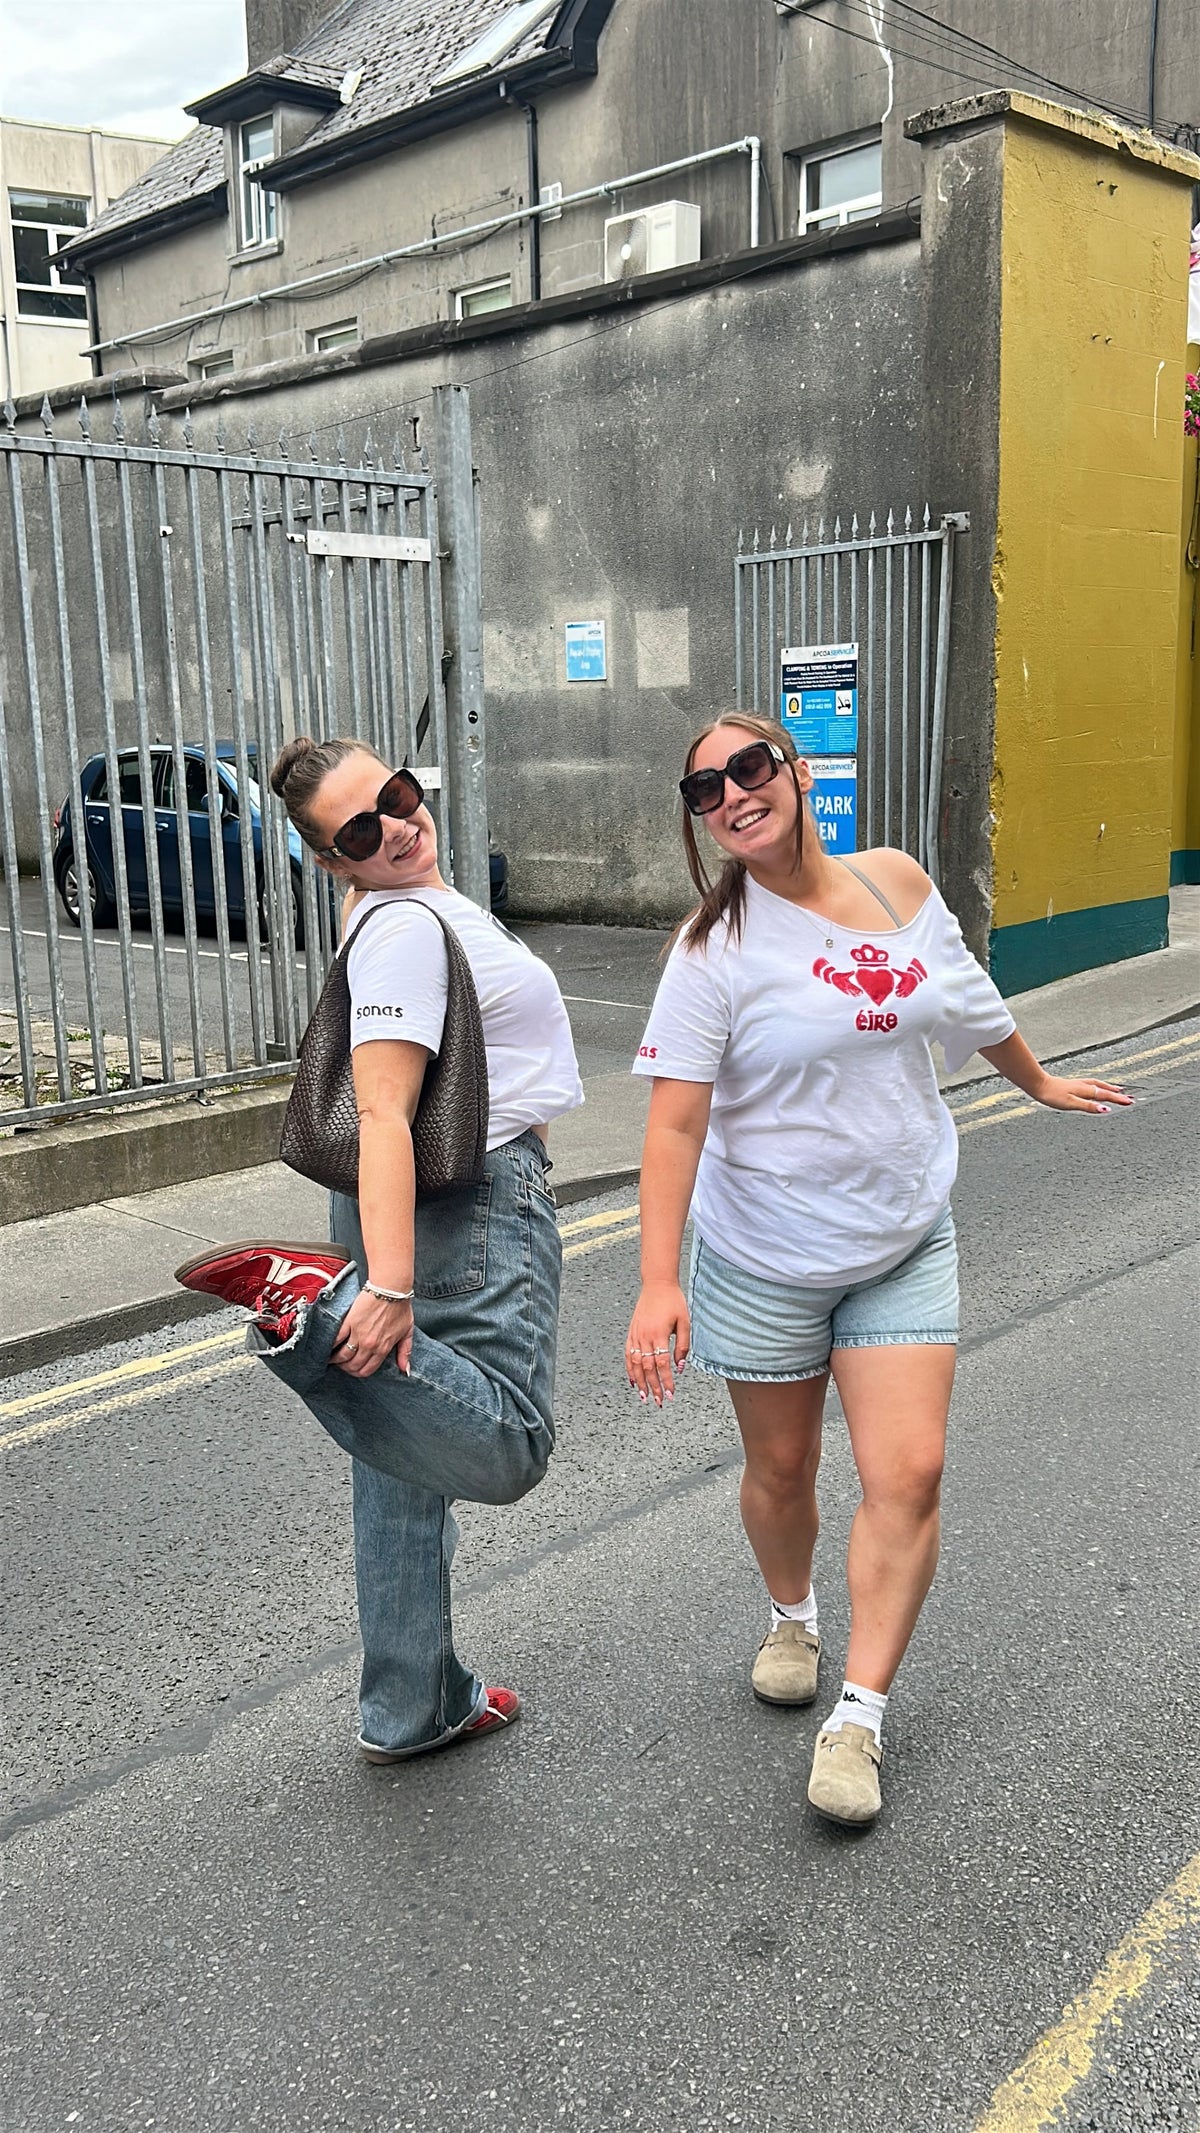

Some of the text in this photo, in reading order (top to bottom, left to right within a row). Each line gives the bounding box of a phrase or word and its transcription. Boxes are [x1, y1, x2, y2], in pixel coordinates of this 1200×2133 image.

[811, 763, 854, 771] APCOASERVICES
[815, 796, 853, 815] PARK
[818, 822, 837, 841] EN
[356, 1005, 404, 1020] sonas
[637, 1046, 659, 1060] as
